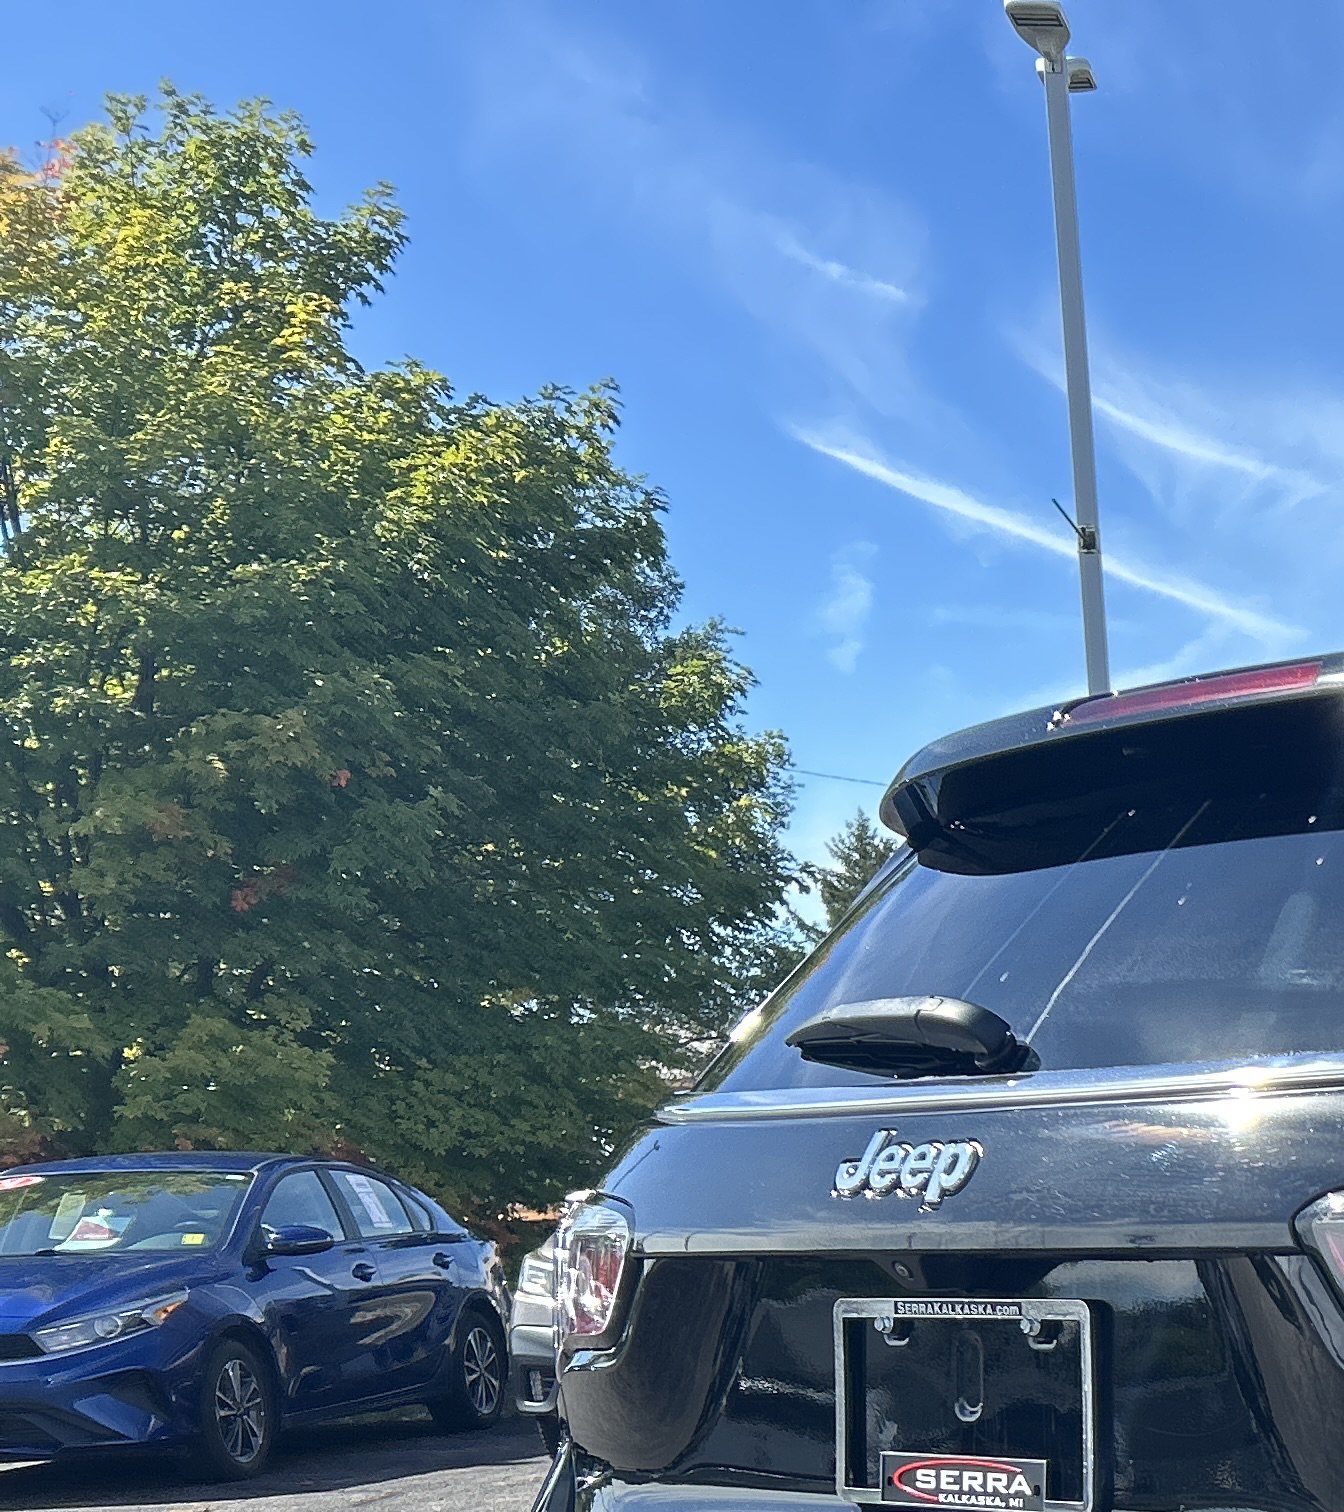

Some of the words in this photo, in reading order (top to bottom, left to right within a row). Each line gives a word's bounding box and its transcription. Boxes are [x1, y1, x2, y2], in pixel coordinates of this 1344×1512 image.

[832, 1127, 984, 1212] Jeep
[914, 1468, 1033, 1496] SERRA
[937, 1493, 1007, 1508] KALKASKA,
[1008, 1497, 1024, 1508] MI
